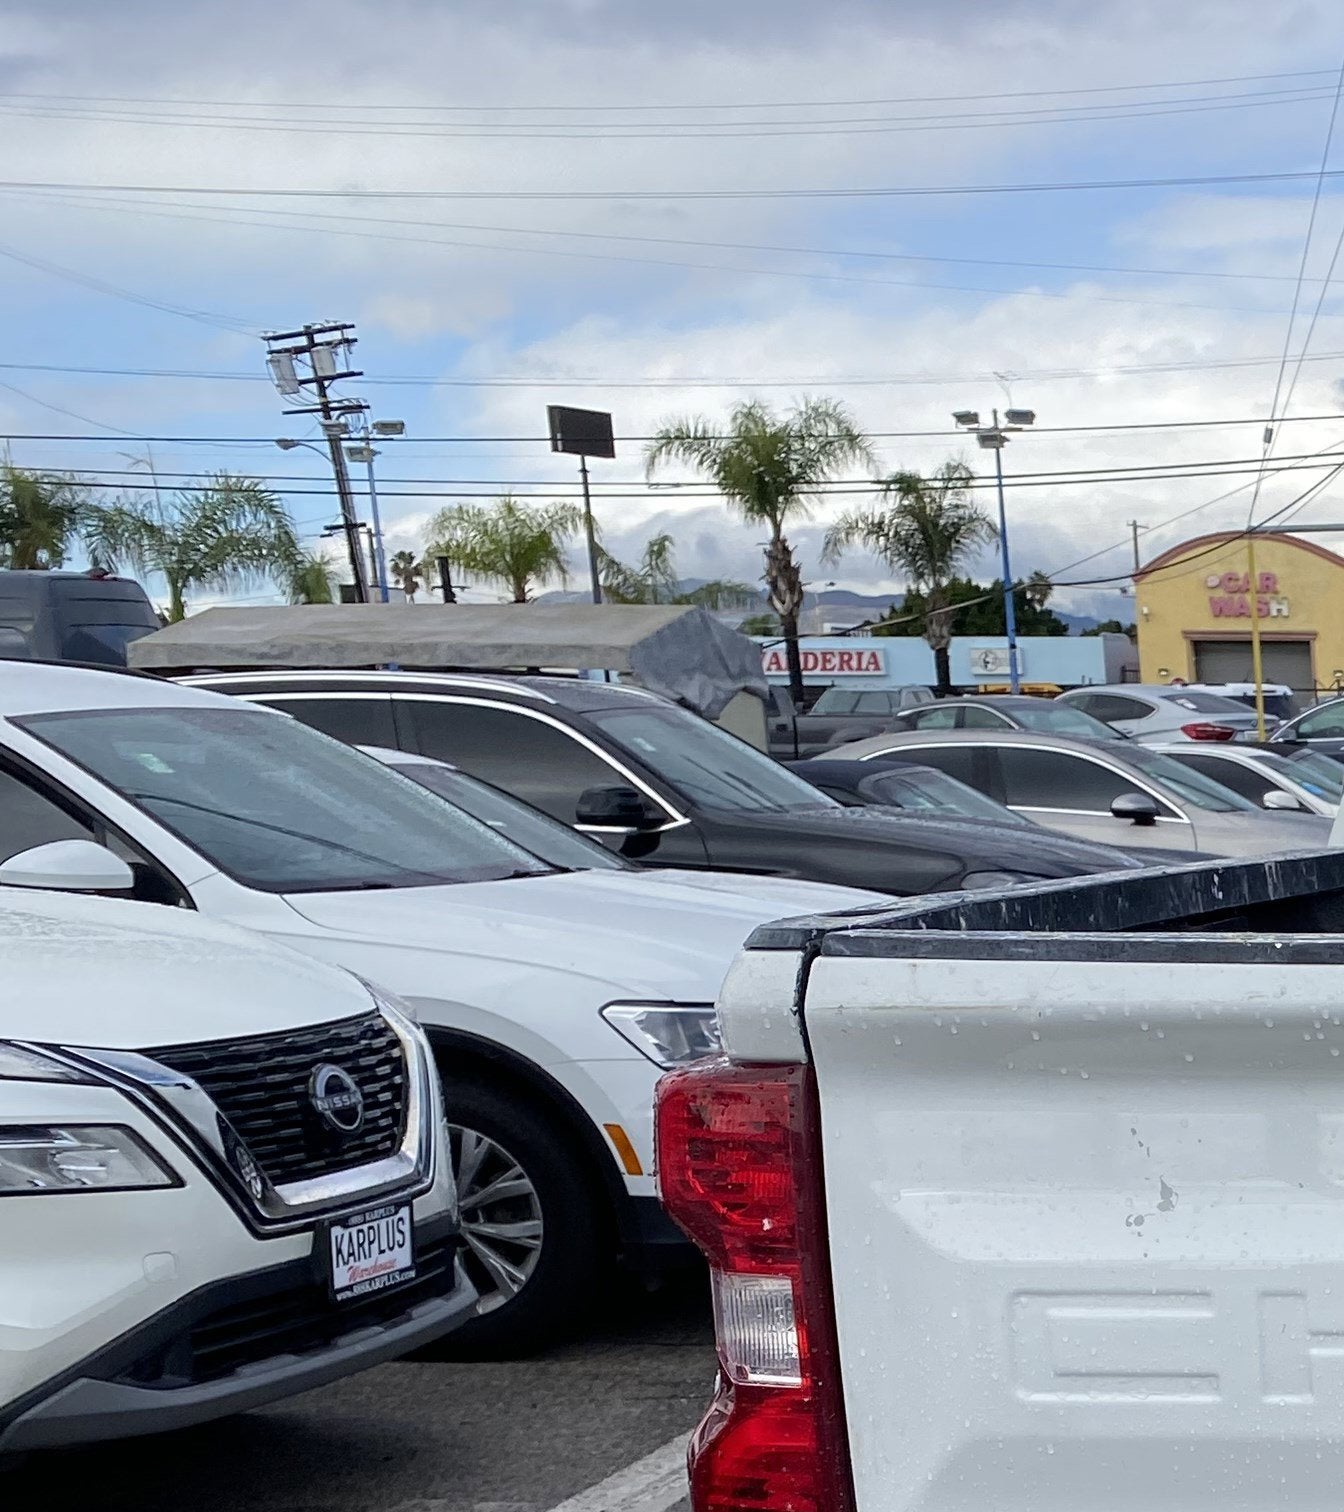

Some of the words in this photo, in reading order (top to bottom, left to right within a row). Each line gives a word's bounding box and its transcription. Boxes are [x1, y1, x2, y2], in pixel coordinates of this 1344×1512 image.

[1208, 595, 1290, 618] WASH
[761, 651, 882, 672] ADERIA
[335, 1217, 406, 1268] KARPLUS
